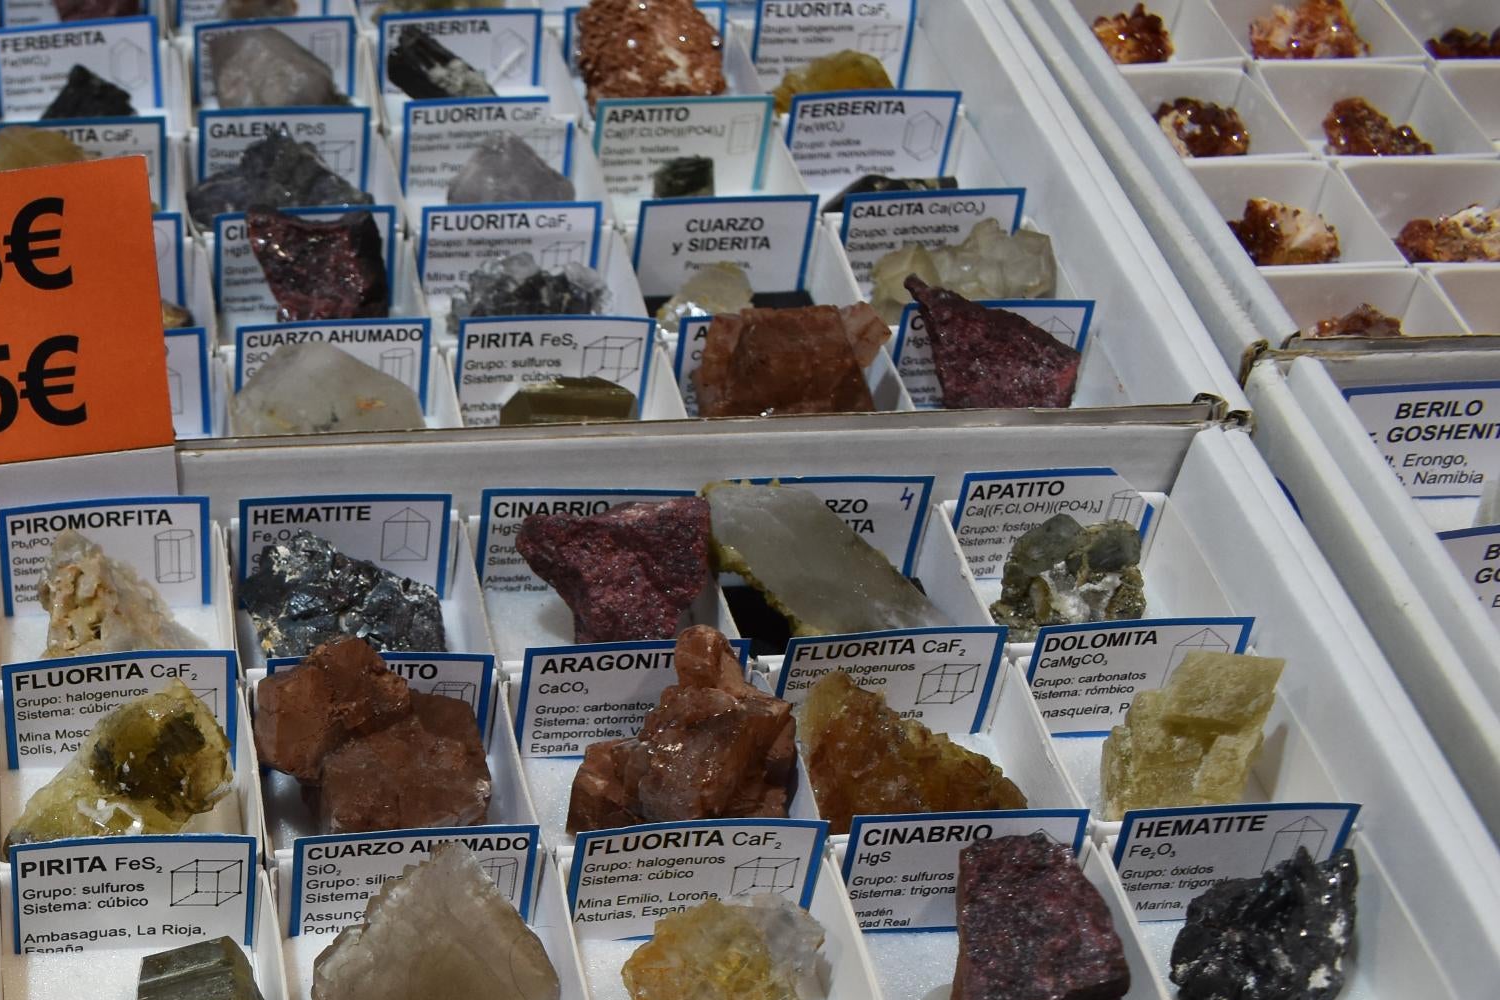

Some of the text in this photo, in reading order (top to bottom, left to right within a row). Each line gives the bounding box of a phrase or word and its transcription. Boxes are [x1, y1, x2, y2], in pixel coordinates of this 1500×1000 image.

[764, 2, 853, 18] FLUORITA
[1, 30, 105, 52] FERBERITA
[412, 106, 505, 125] FLUORITA
[607, 107, 690, 124] APATITO
[799, 101, 906, 119] FERBERITA
[210, 121, 326, 139] GALENA PbS
[852, 202, 925, 219] CALCITA
[430, 213, 530, 231] FLUORITA
[686, 217, 764, 233] CUARZO
[672, 235, 771, 254] y SIDERITA
[246, 328, 423, 349] CUARZO AHUMADO
[466, 333, 534, 350] PIRITA
[512, 356, 562, 368] sulfuros
[1395, 399, 1484, 420] BERILO
[1386, 423, 1500, 443] GOSHENIT
[1403, 453, 1468, 467] Erongo,
[1413, 471, 1484, 485] Namibia
[969, 480, 1065, 501] APATITO
[253, 505, 372, 525] HEMATITE
[494, 500, 609, 519] CINABRIO
[10, 509, 173, 537] PIROMORFITA
[795, 638, 916, 663] FLUORITA
[1044, 629, 1158, 652] DOLOMITA
[541, 653, 675, 675] ARAGONIT
[15, 663, 145, 692] FLUORITA
[1078, 671, 1147, 684] carbonatos
[532, 725, 628, 741] Camporrobles,
[863, 824, 993, 846] CINABRIO
[1135, 815, 1268, 839] HEMATITE
[307, 839, 404, 861] CUARZO
[588, 829, 724, 856] FLUORITA
[20, 855, 107, 879] PIRITA
[857, 851, 892, 866] HgS
[22, 881, 145, 901] Grupo: sulfuros
[24, 923, 206, 945] Ambasaguas, La Rioja,
